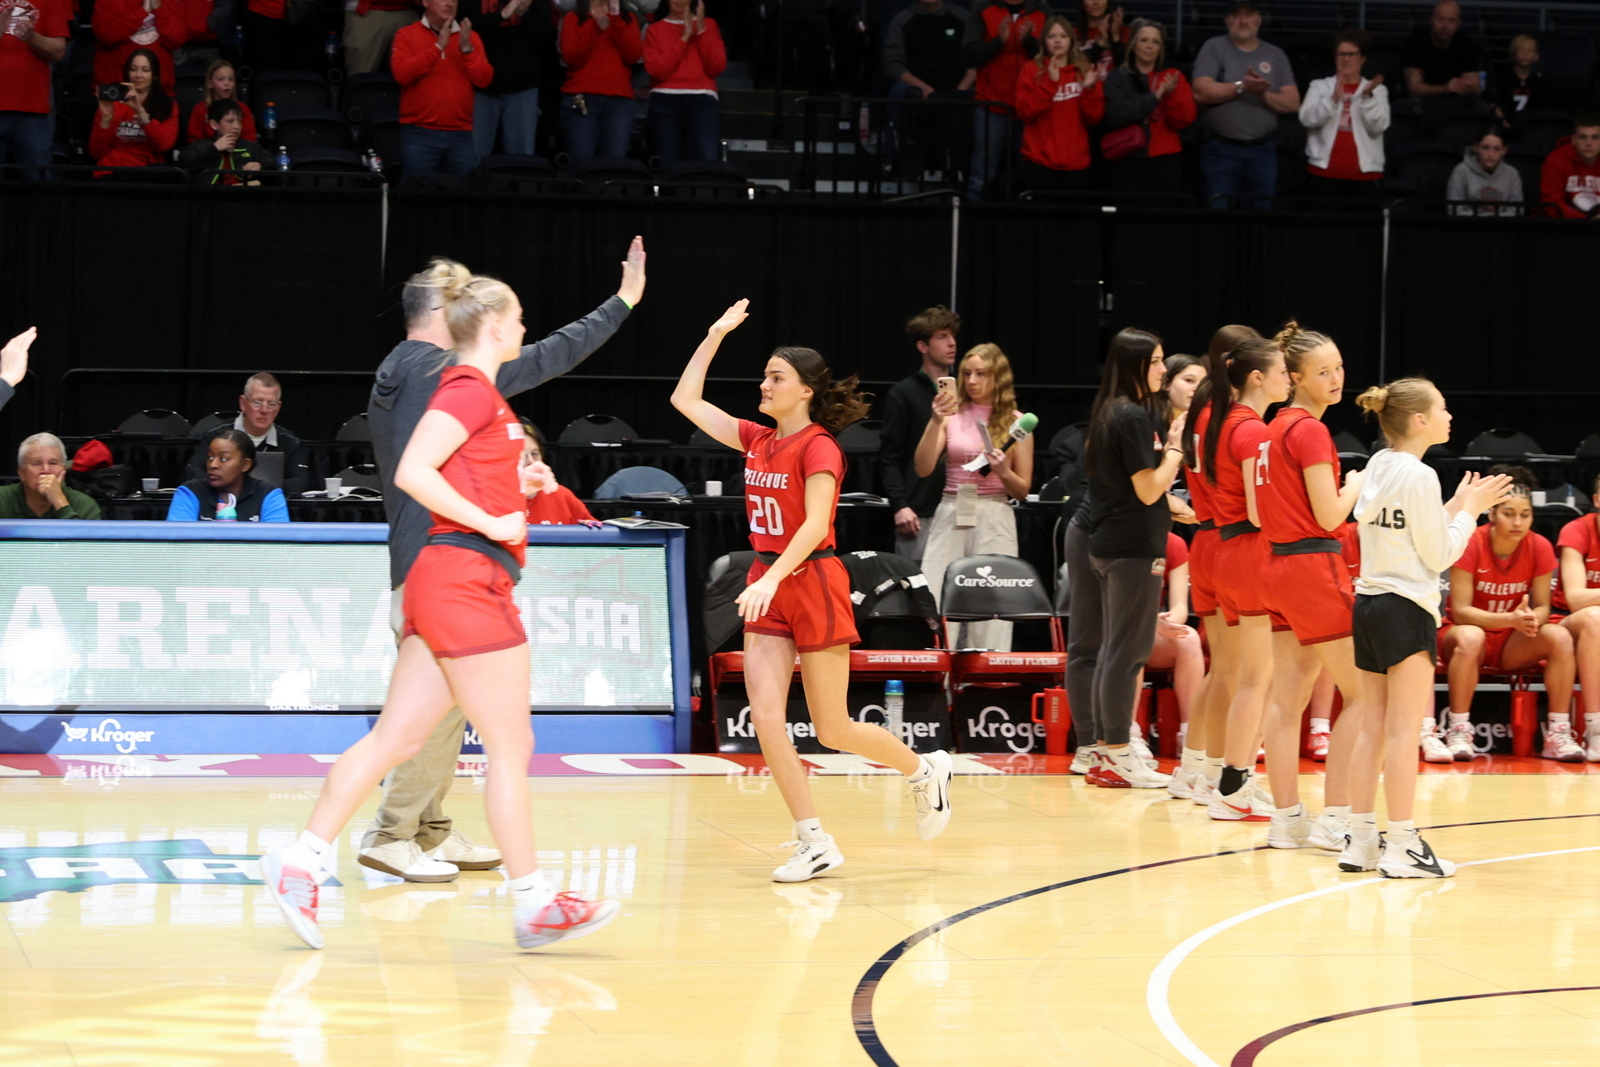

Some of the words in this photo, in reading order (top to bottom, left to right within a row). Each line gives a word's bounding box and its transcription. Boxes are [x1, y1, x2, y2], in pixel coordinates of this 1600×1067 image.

[1513, 95, 1528, 111] 7
[748, 494, 785, 536] 20
[954, 574, 1036, 587] CareSource
[868, 655, 903, 663] DAYTON
[905, 655, 939, 663] FLYERS
[989, 657, 1024, 665] DAYTON
[1026, 657, 1059, 665] FLYERS
[91, 718, 155, 754] Kroger
[968, 706, 1047, 753] Kroge
